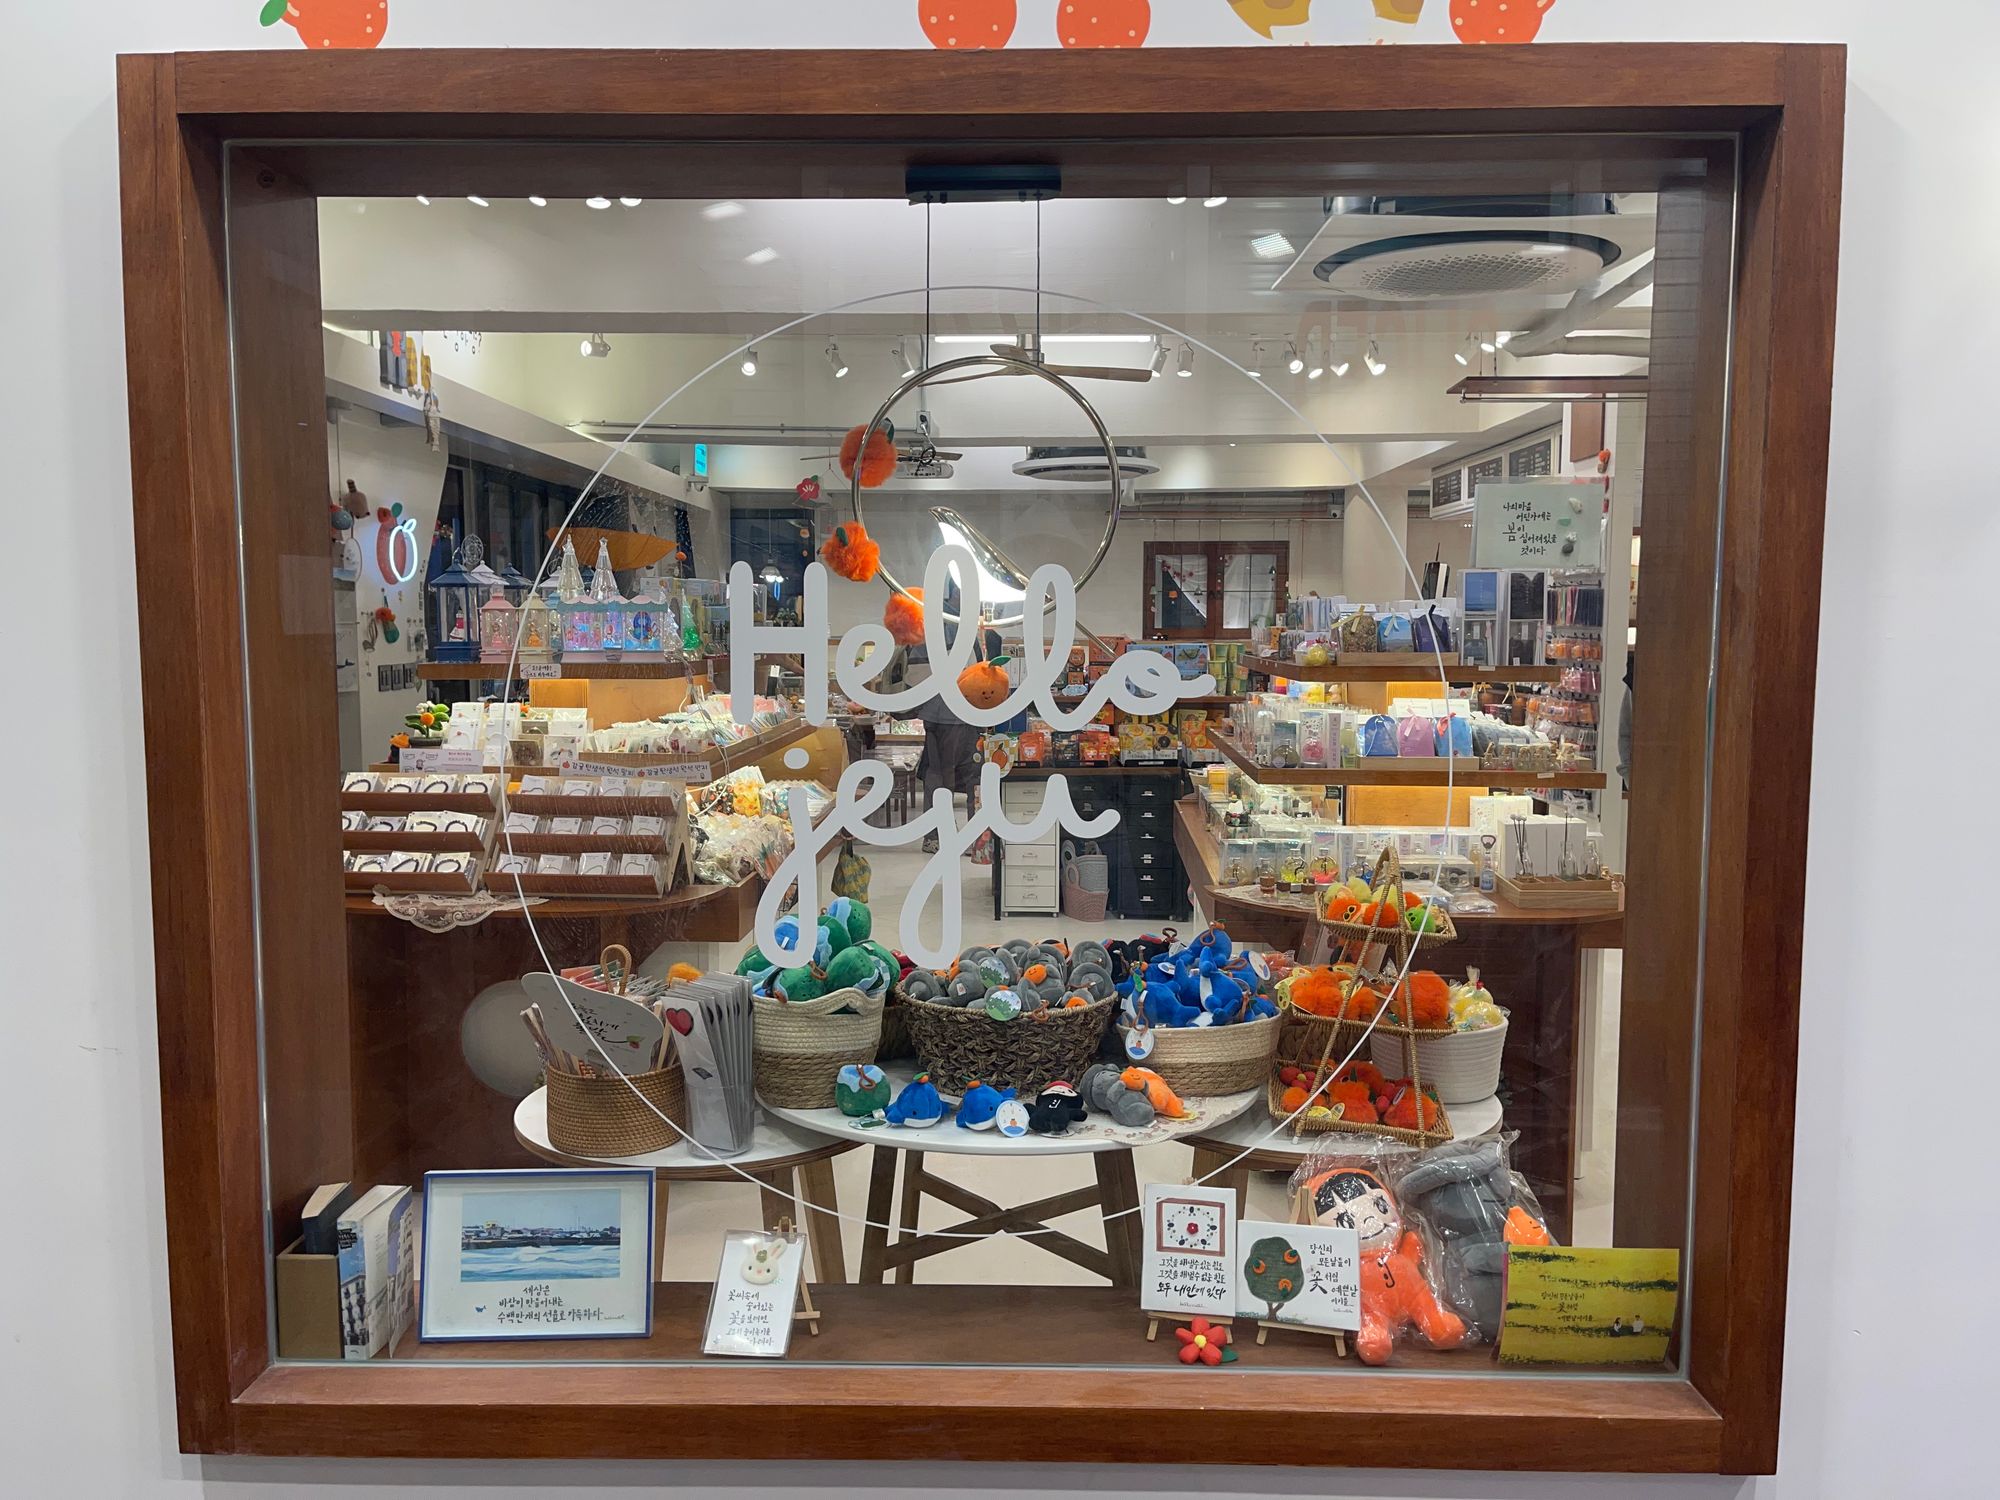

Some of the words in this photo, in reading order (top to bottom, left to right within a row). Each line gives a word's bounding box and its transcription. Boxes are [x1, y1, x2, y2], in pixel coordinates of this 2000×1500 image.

[1520, 545, 1546, 557] 것이다
[729, 544, 1216, 732] Hello
[755, 748, 1120, 969] jeju
[1309, 1243, 1333, 1256] 당신의
[1158, 1256, 1179, 1268] 그것을
[1157, 1269, 1179, 1281] 그것을
[522, 1284, 551, 1297] 세상은
[1206, 1286, 1227, 1301] 있다
[498, 1296, 524, 1309] 바람이
[525, 1296, 564, 1309] 만들어내는
[542, 1309, 566, 1323] 선율로
[567, 1307, 604, 1322] 가득하다
